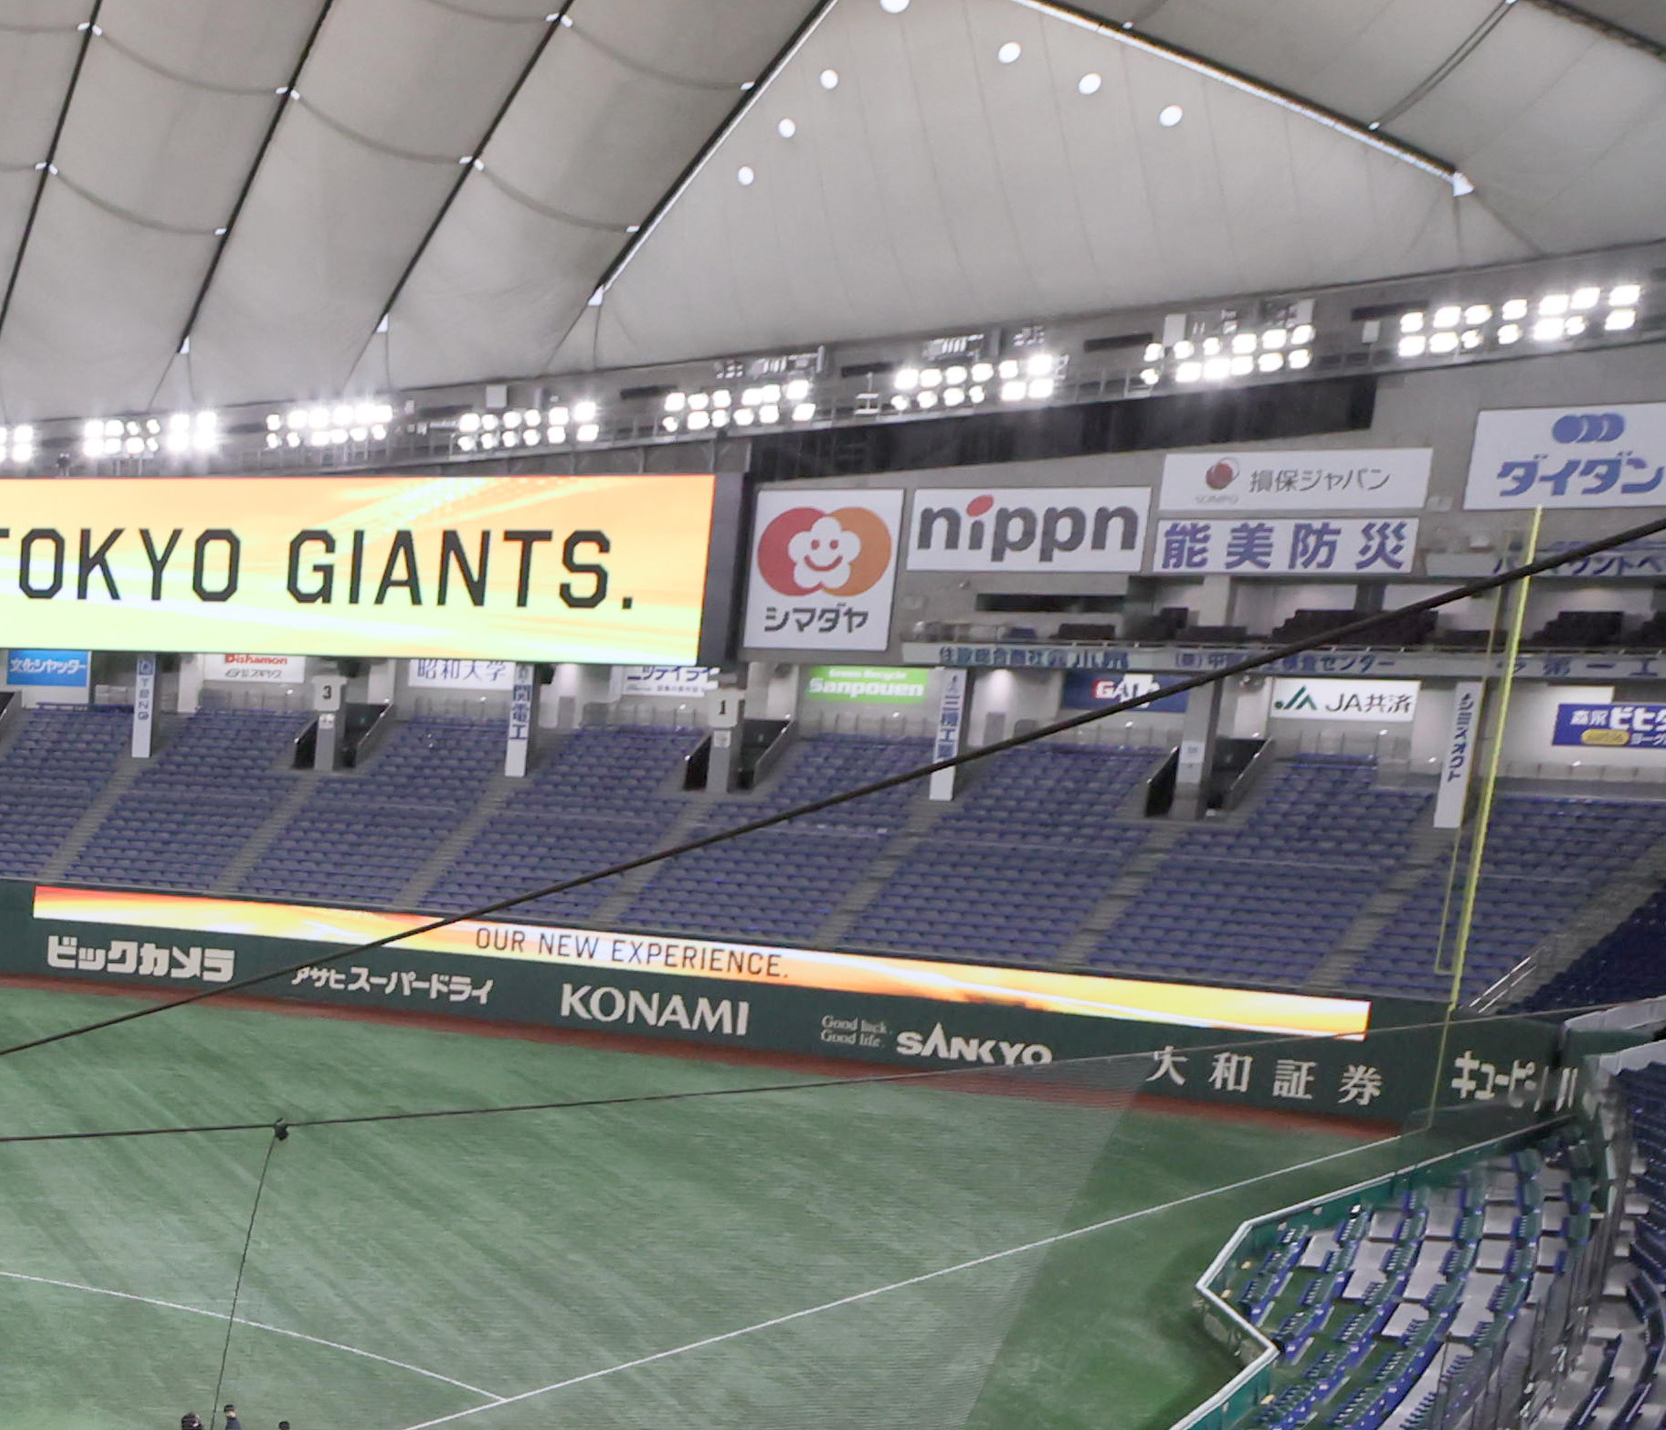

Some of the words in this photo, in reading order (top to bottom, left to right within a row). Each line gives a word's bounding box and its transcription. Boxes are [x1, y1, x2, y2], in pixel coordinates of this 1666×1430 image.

[1251, 468, 1391, 493] 損保ジャパン
[1497, 451, 1665, 497] ダイダン
[917, 494, 1138, 563] nippn
[1162, 521, 1408, 571] 能美防災
[288, 529, 634, 610] GIANTS.
[764, 602, 868, 634] シマダヤ
[10, 658, 87, 674] 文化シャッター
[322, 685, 332, 700] 3
[809, 677, 925, 698] Sanpouen
[1326, 693, 1412, 713] JA共済
[48, 935, 235, 982] ビックカメラ
[476, 927, 525, 953] OUR
[539, 933, 598, 959] NEW
[612, 939, 790, 979] EXPERIENCE.
[292, 966, 494, 1005] アサヒスーパードライ
[560, 982, 749, 1036] KONAMI
[822, 1015, 858, 1031] Good
[820, 1029, 857, 1046] Good
[897, 1022, 1053, 1065] SANKYO
[1146, 1045, 1383, 1107] 大和証券
